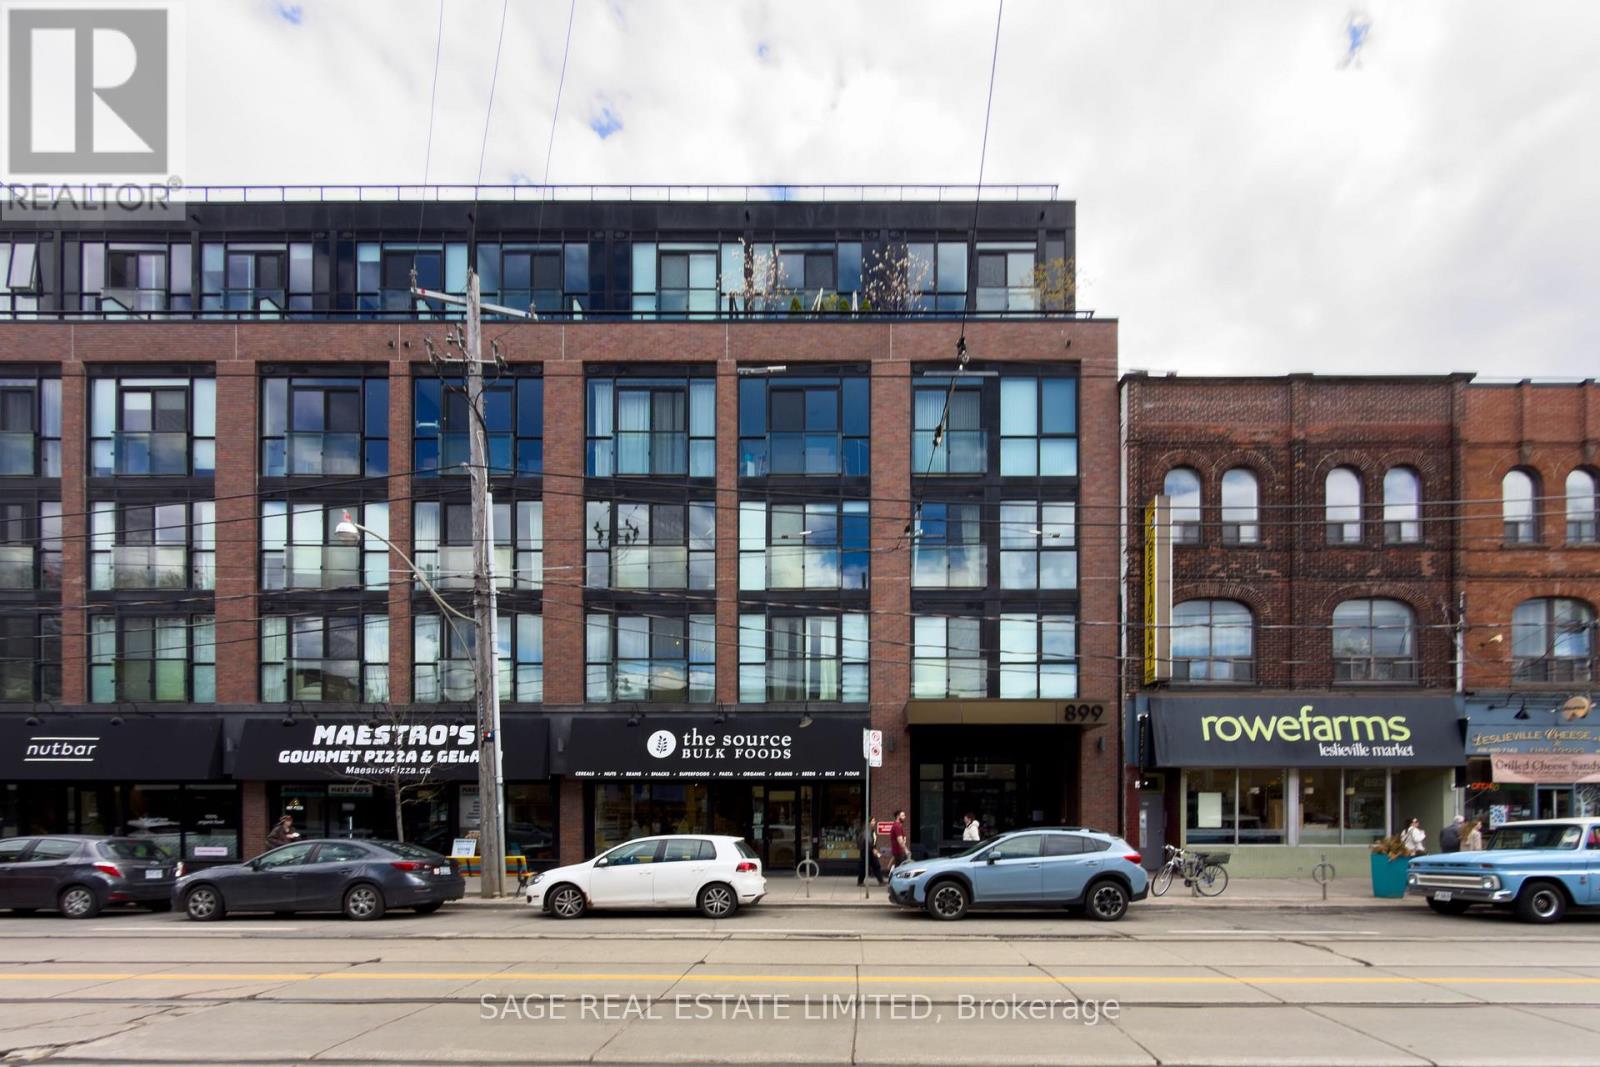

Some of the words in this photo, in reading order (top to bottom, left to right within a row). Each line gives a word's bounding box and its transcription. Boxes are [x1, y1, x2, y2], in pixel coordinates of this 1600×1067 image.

[1064, 703, 1103, 721] 899
[1201, 705, 1411, 742] rowefarms
[313, 725, 475, 746] MAESTRO'S
[683, 727, 715, 746] the
[723, 735, 792, 746] source
[1472, 730, 1543, 746] LESLIEVILLE
[1545, 728, 1590, 740] CHEESE
[26, 742, 97, 756] nutbar
[278, 750, 362, 763] GOURMET
[364, 750, 417, 763] PIZZA
[420, 750, 433, 763] &
[436, 750, 503, 763] GELA
[682, 748, 725, 759] BULK
[735, 748, 792, 759] FOODS
[1319, 742, 1370, 757] leslieville
[1372, 743, 1414, 757] market
[1495, 760, 1530, 770] Grilled
[1532, 759, 1568, 771] Cheese
